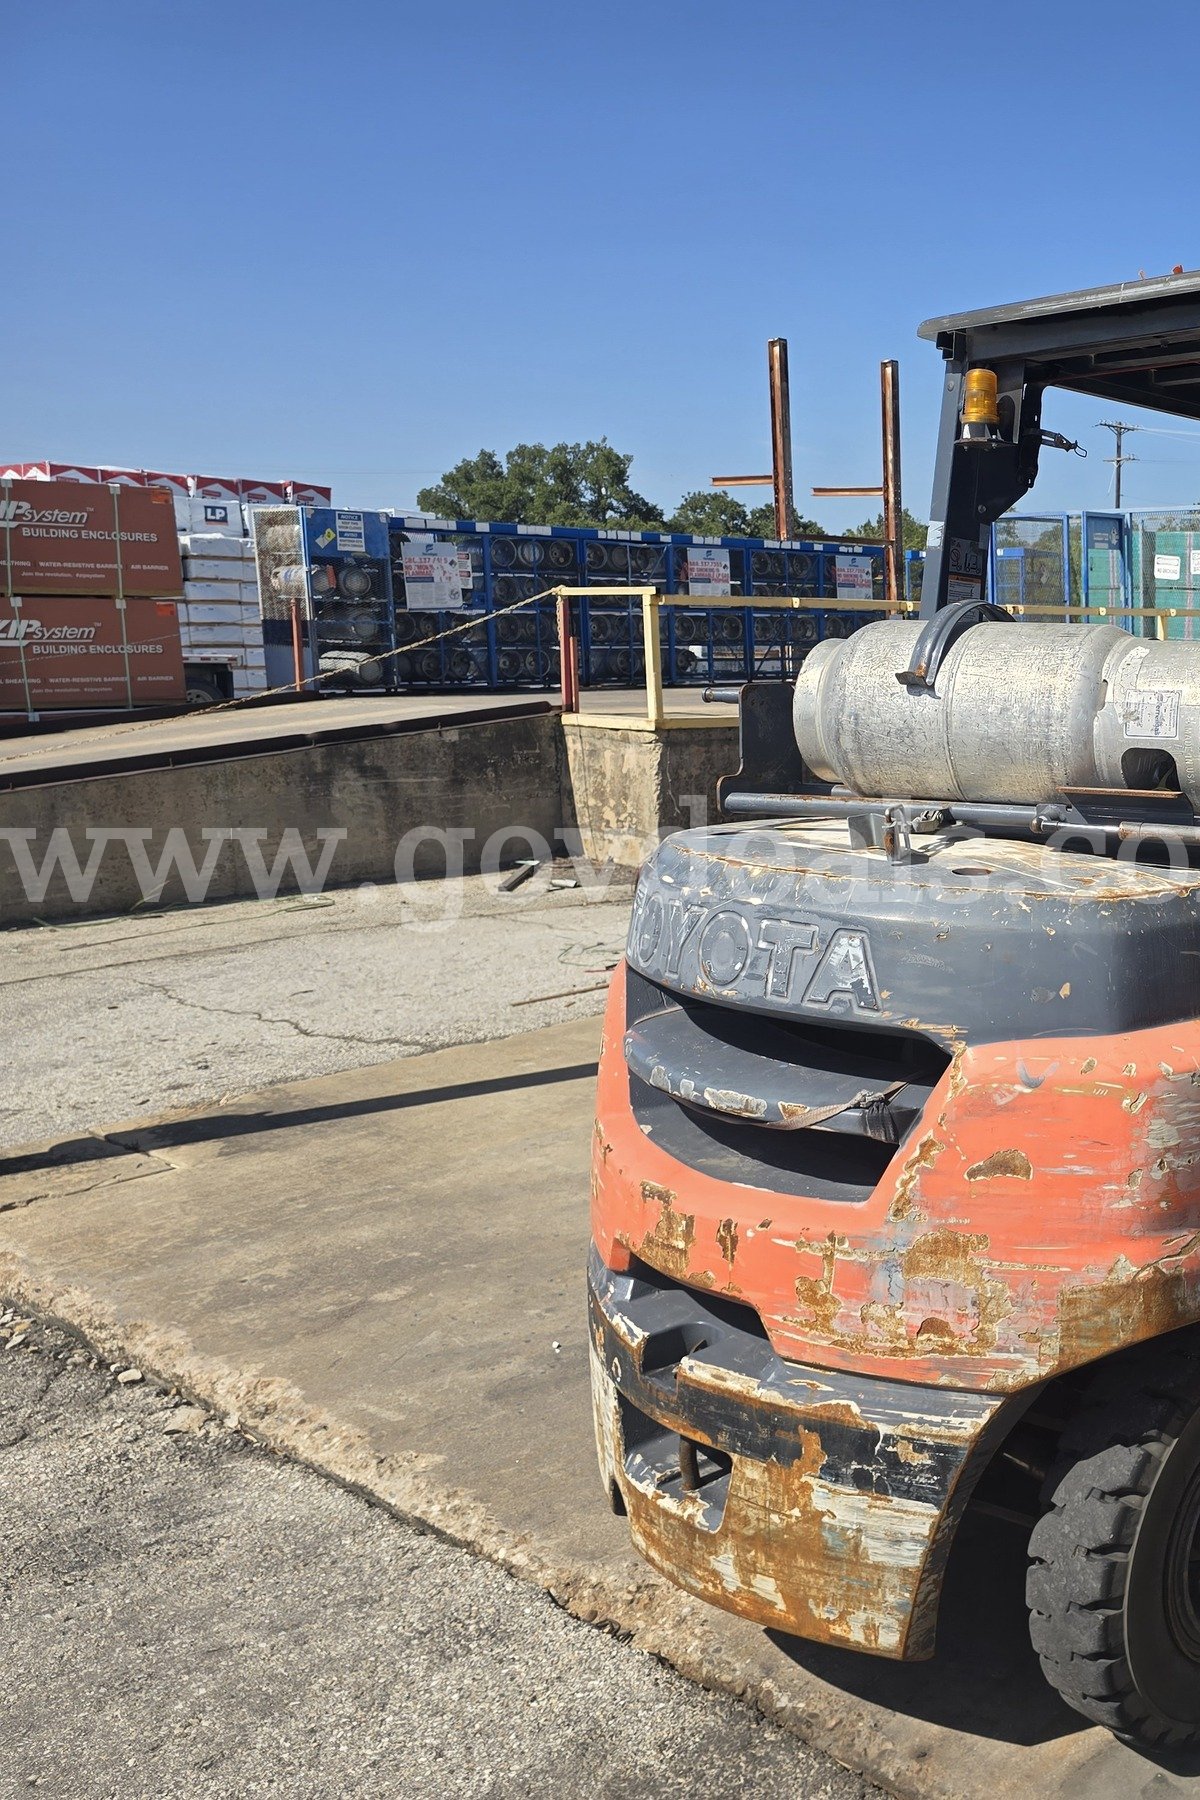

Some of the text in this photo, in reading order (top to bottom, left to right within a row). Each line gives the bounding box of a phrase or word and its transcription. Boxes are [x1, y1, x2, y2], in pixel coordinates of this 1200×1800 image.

[206, 507, 226, 521] LP
[22, 527, 158, 542] BUILDING ENCLOSURES
[32, 644, 164, 655] BUILDING ENCLOSURES
